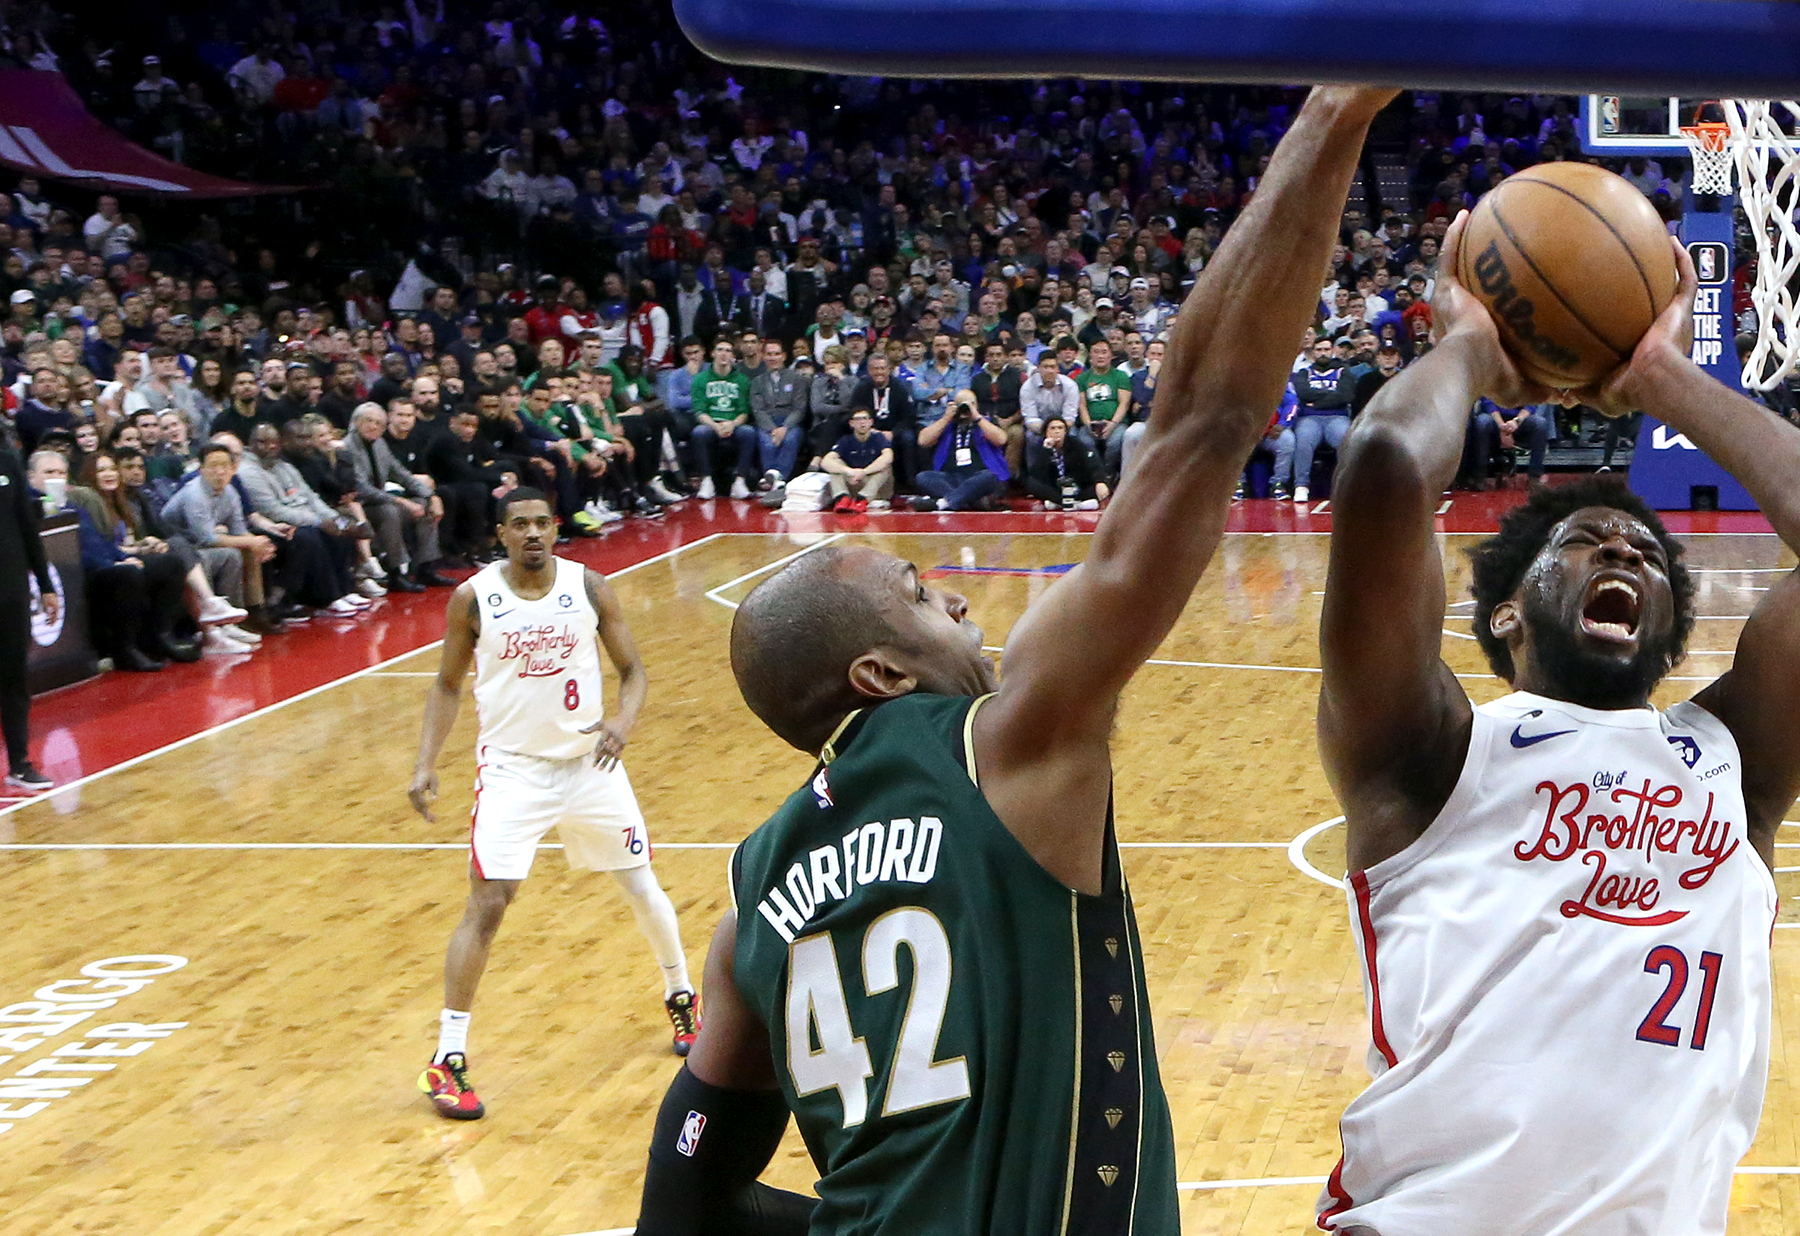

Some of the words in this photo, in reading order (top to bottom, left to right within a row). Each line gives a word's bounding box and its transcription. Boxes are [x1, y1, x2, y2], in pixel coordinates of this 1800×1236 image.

[1473, 239, 1581, 371] Wilson
[1693, 288, 1722, 313] GET
[1692, 315, 1722, 339] THE
[1692, 341, 1722, 365] APP
[498, 624, 579, 659] Brotherly
[518, 653, 567, 678] Love
[564, 679, 580, 711] 8
[1593, 771, 1614, 794] City
[1616, 770, 1628, 785] of
[622, 825, 643, 855] 76
[1513, 778, 1740, 889] Brotherly
[757, 816, 943, 944] HORFORD
[1560, 850, 1691, 927] Love
[1635, 945, 1723, 1051] 21
[785, 906, 971, 1128] 42
